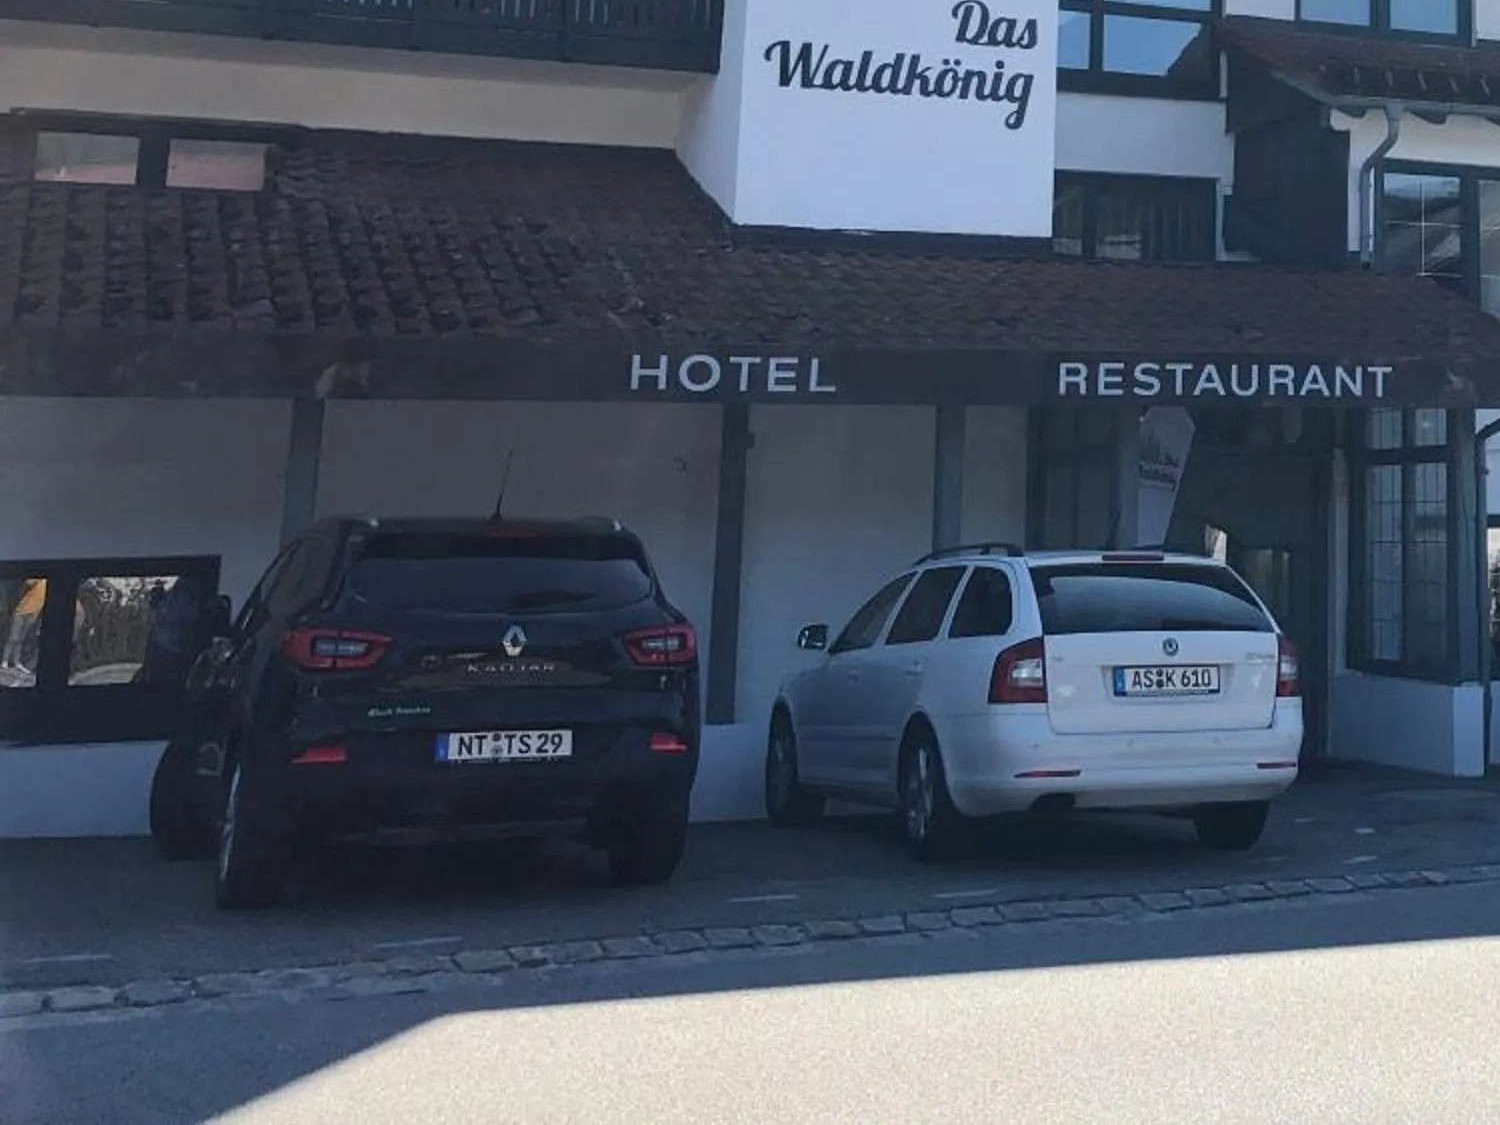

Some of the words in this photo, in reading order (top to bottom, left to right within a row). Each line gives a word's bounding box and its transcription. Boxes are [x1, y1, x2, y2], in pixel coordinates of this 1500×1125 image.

[951, 0, 1038, 50] Das
[763, 40, 1035, 130] Waldkönig
[630, 354, 837, 392] HOTEL
[1058, 361, 1393, 398] RESTAURANT
[1181, 668, 1212, 687] 610
